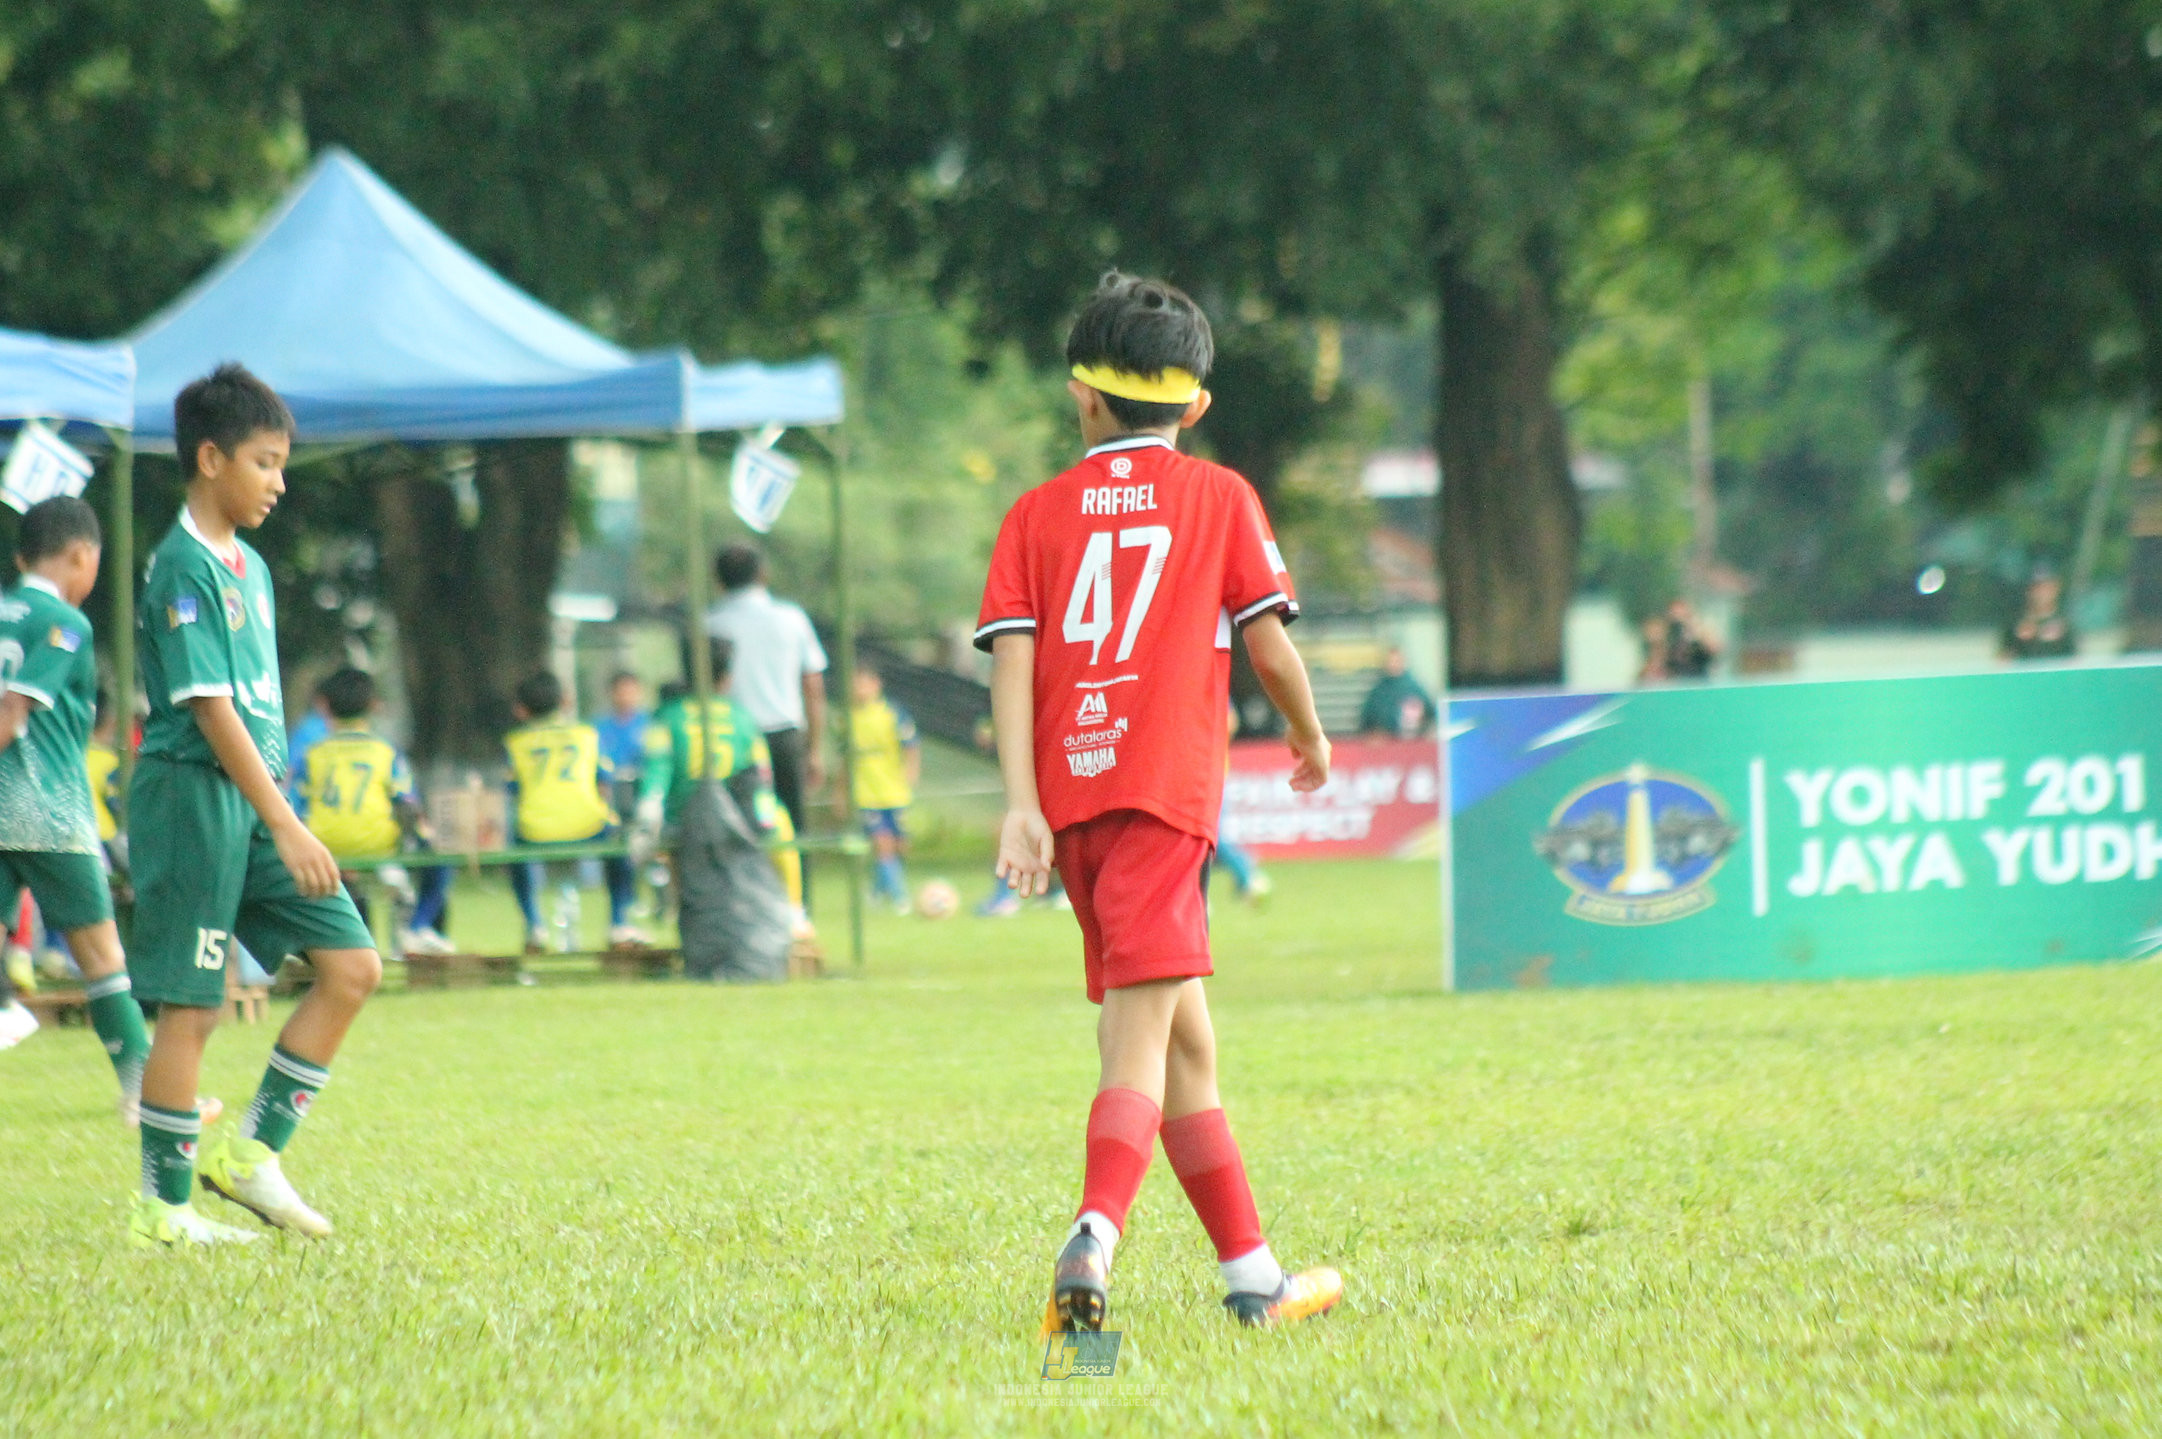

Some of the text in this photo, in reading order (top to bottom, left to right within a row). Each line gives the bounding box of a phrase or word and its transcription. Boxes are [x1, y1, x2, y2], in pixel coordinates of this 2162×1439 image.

[1081, 483, 1158, 516] RAFAEL
[1062, 525, 1172, 666] 47
[1064, 729, 1122, 748] dutalaras
[1066, 747, 1117, 773] YAMAHA
[1784, 753, 2145, 828] YONIF 201
[1787, 830, 1966, 898] JAYA
[195, 927, 227, 971] 15
